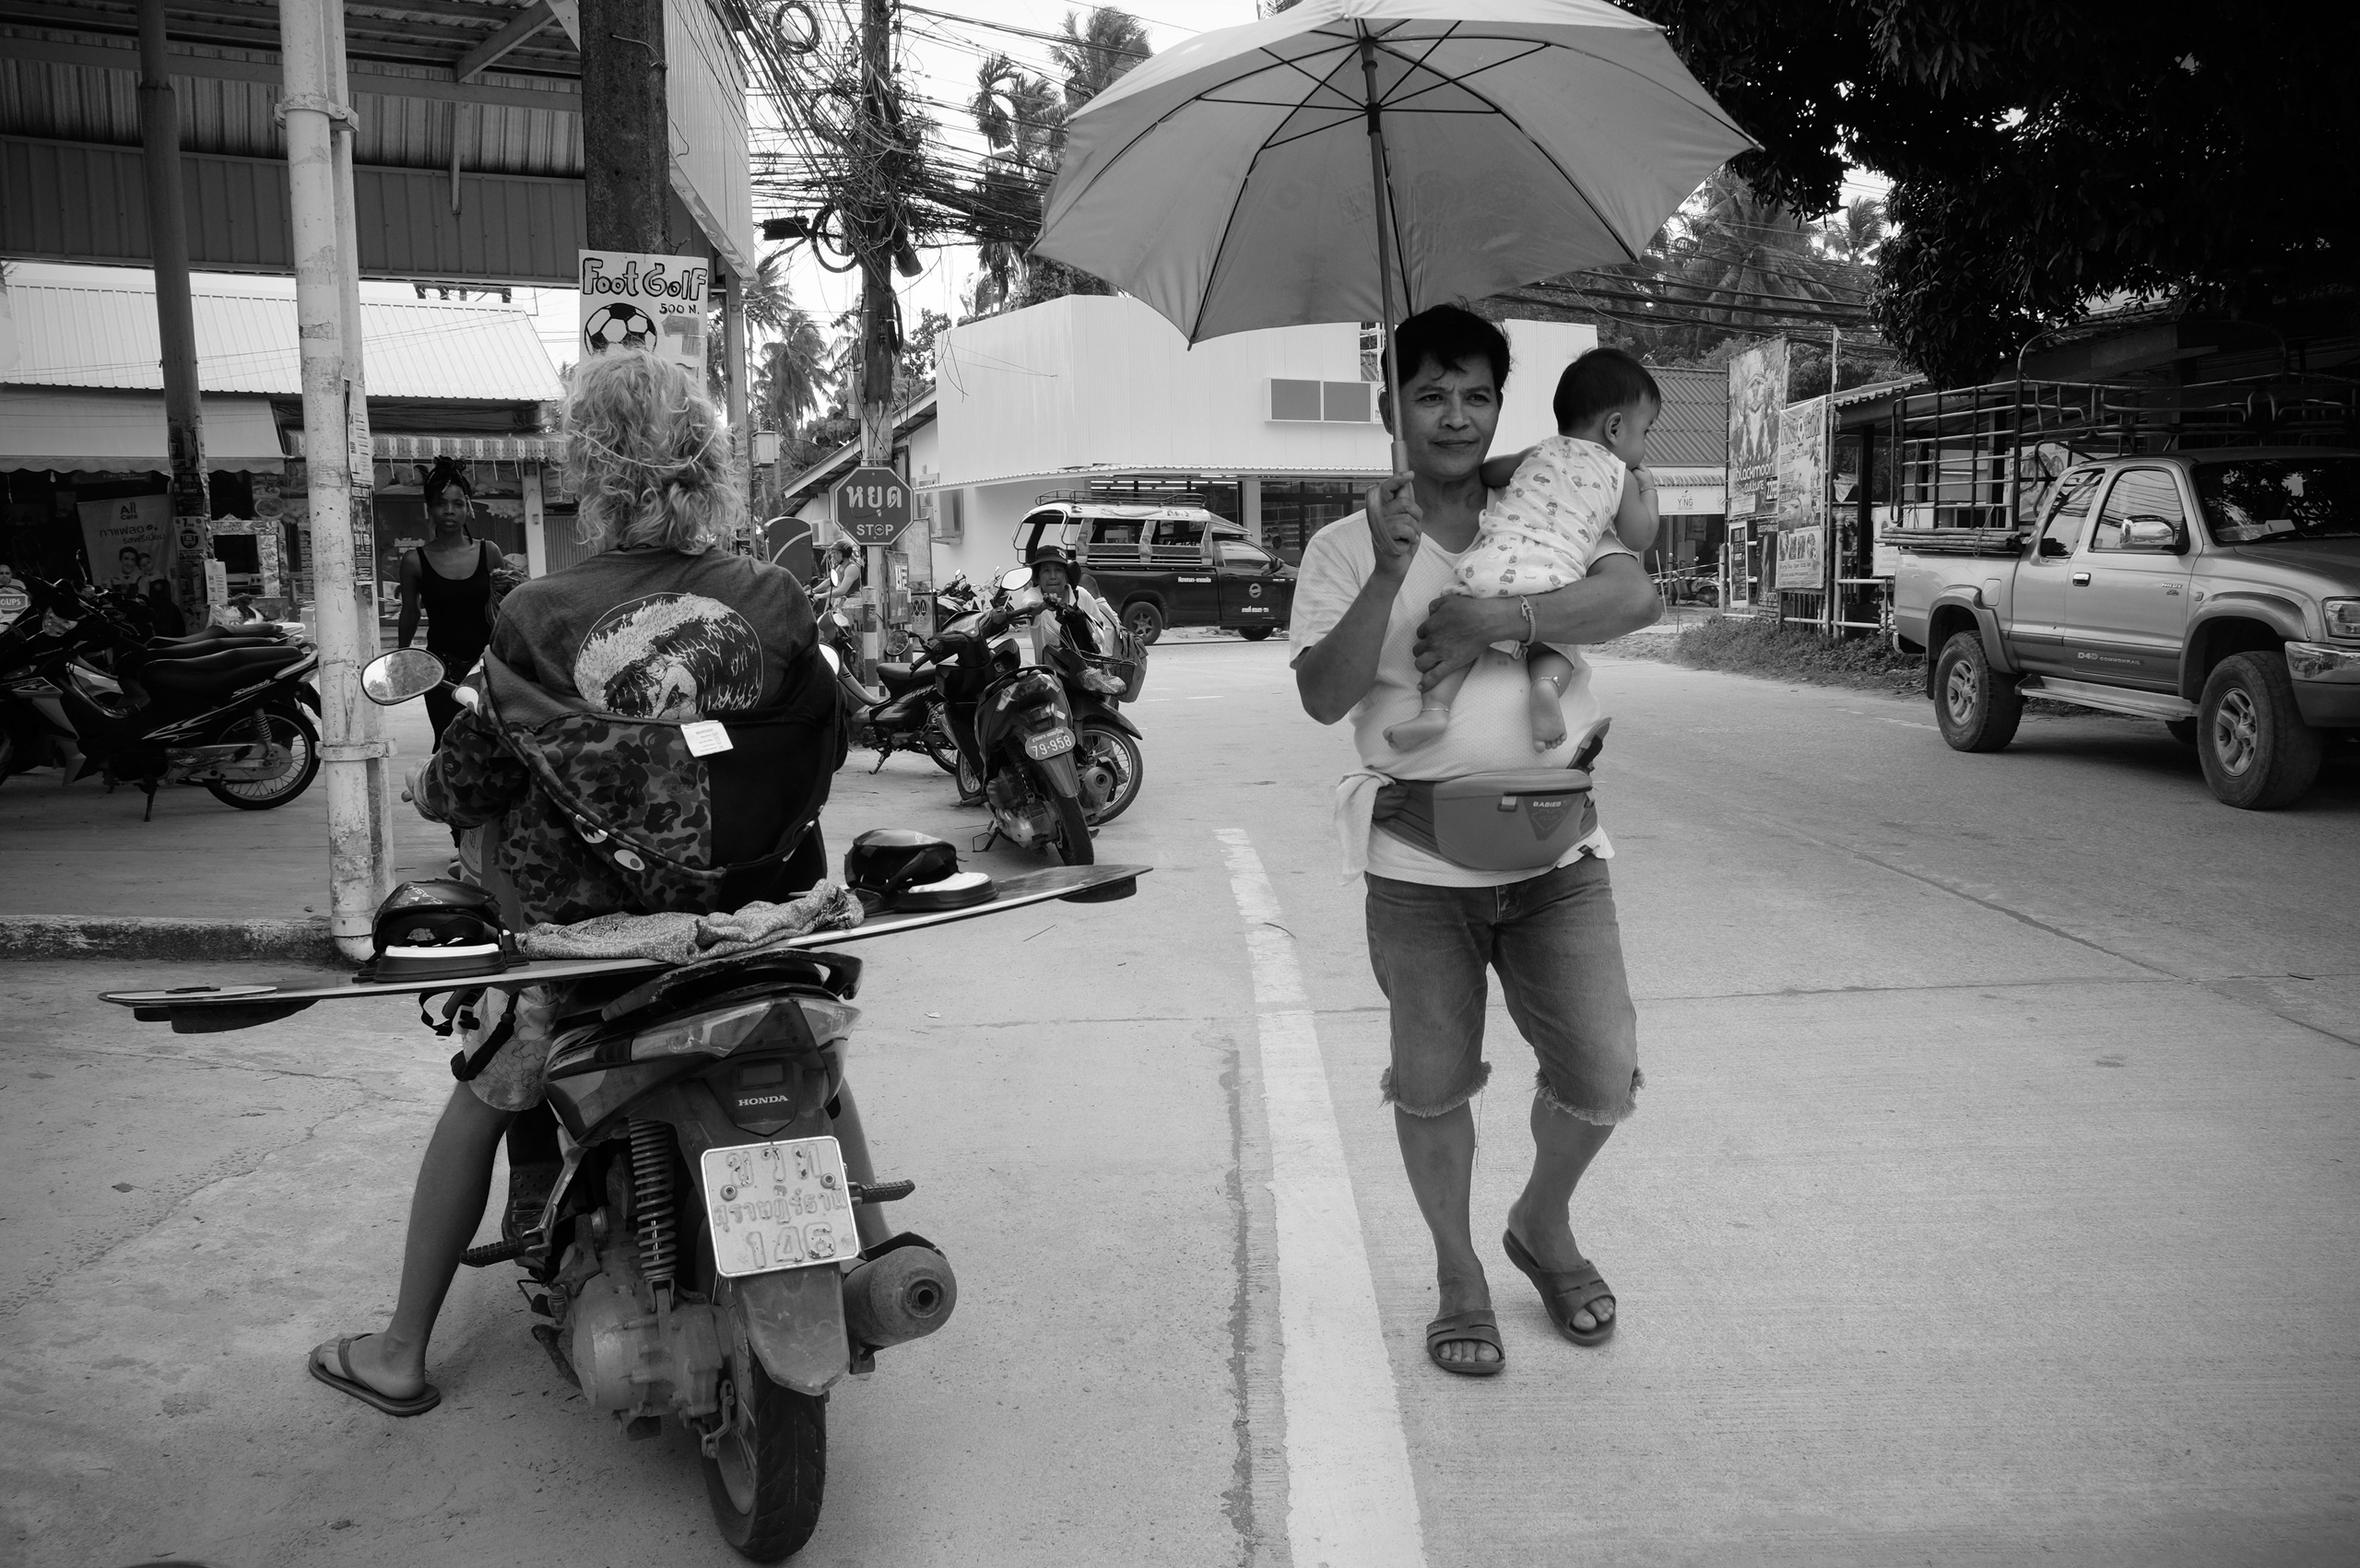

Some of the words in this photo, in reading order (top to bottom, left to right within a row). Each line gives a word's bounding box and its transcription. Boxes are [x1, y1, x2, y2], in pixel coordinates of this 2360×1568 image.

[583, 257, 639, 296] Foot
[659, 302, 685, 314] 500
[121, 501, 136, 514] All
[846, 486, 902, 516] หยุด
[1678, 498, 1693, 507] YNG
[856, 524, 894, 536] STOP
[230, 679, 272, 698] Smash
[738, 1094, 789, 1107] HONDA
[746, 1220, 837, 1269] 146
